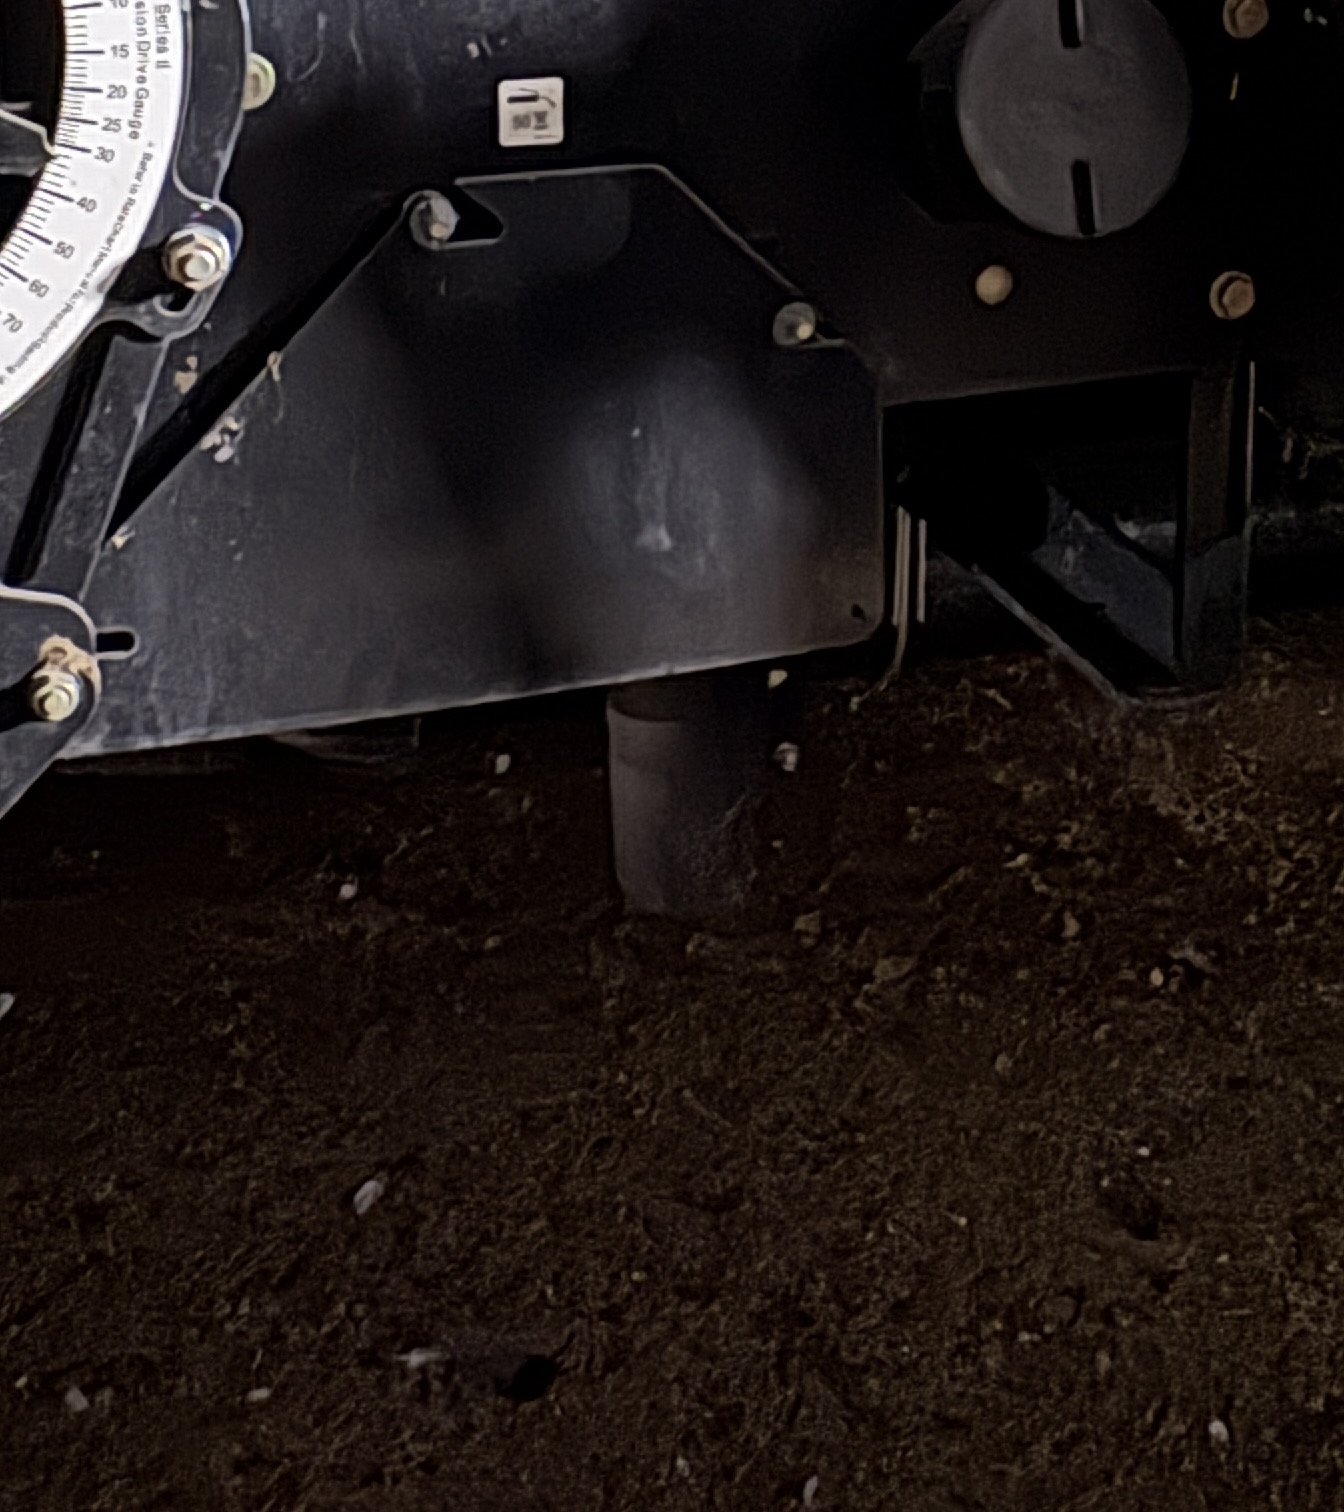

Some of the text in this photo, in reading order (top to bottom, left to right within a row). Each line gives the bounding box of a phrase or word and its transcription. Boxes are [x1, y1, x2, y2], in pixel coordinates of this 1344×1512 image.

[154, 4, 172, 54] Series
[110, 44, 130, 59] 15
[136, 40, 151, 84] Drive
[106, 84, 128, 99] 20
[127, 87, 150, 140] Gauge
[100, 116, 122, 133] 25
[93, 146, 115, 163] 30
[76, 196, 97, 213] 40
[53, 240, 76, 259] 50
[28, 279, 50, 297] 60
[2, 312, 24, 333] 70
